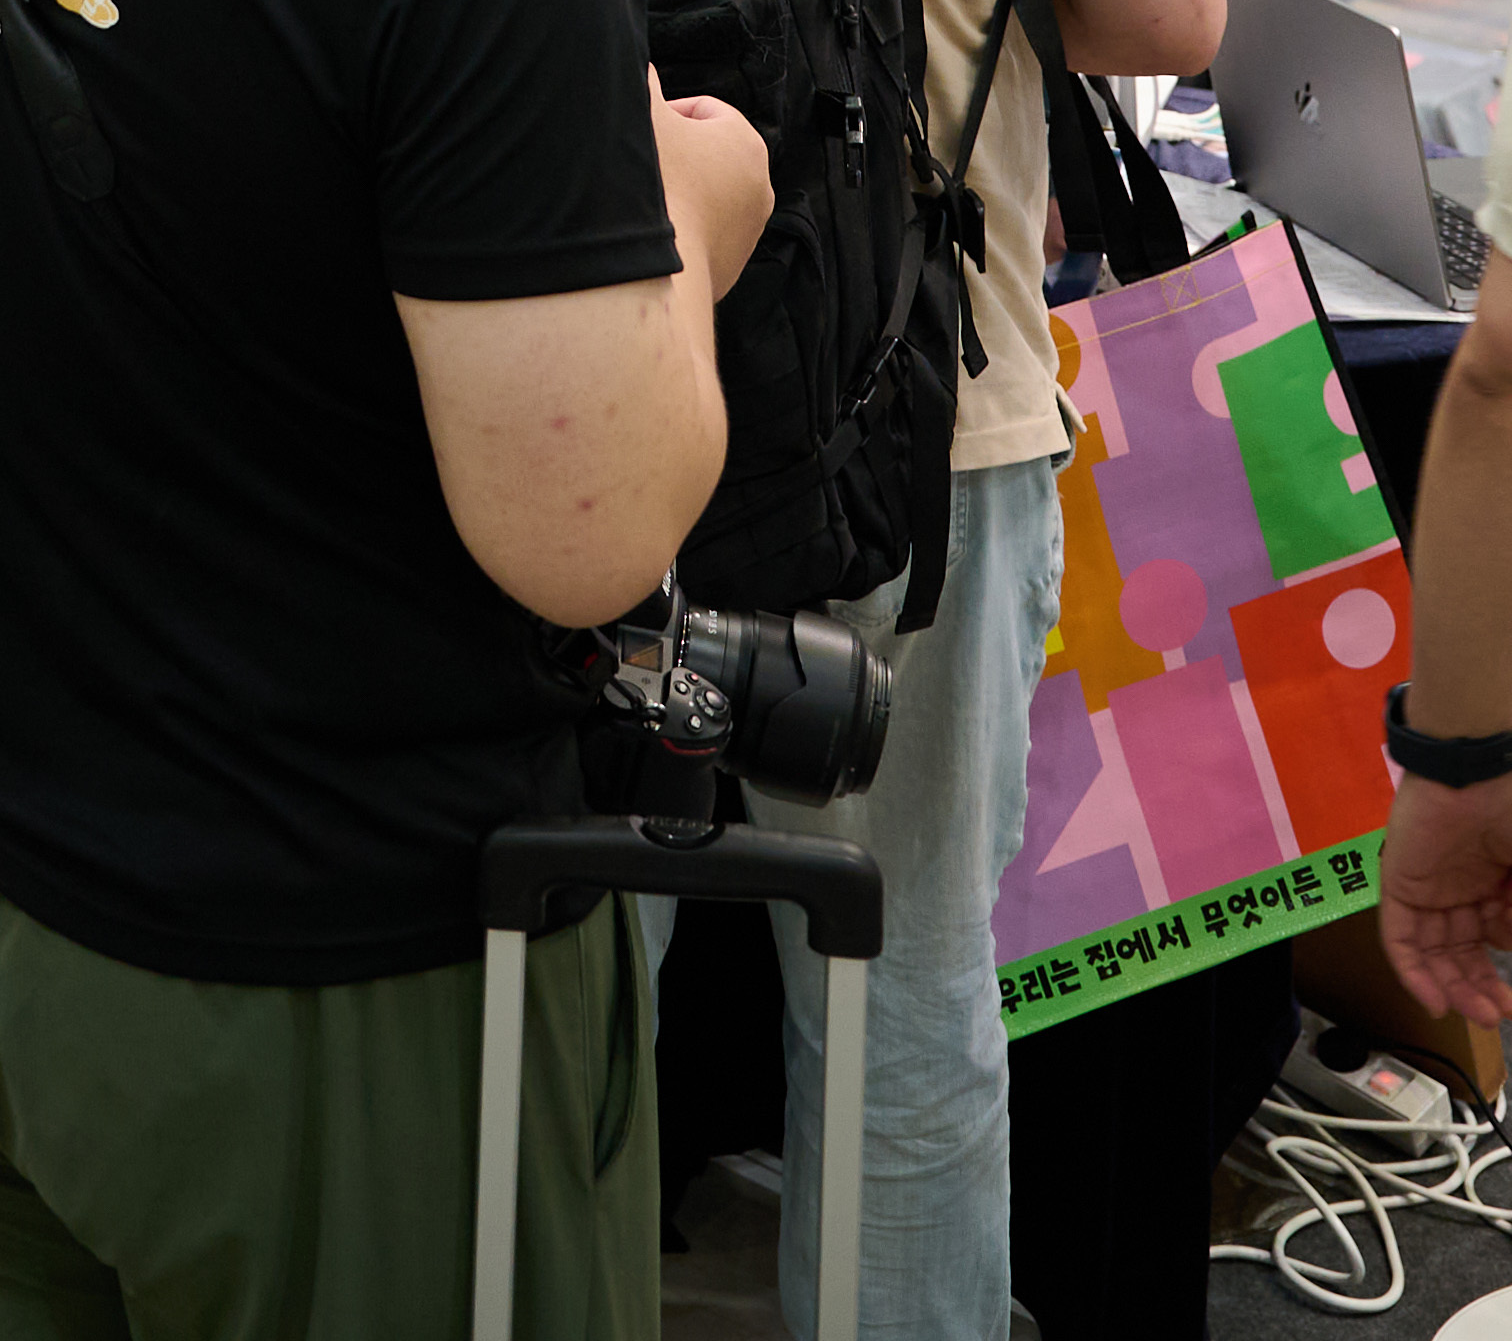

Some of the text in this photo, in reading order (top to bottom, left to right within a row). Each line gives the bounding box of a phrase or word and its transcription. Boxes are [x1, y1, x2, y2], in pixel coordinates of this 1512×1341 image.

[998, 850, 1369, 1015] 우리는 집에서 무엇이든 할
